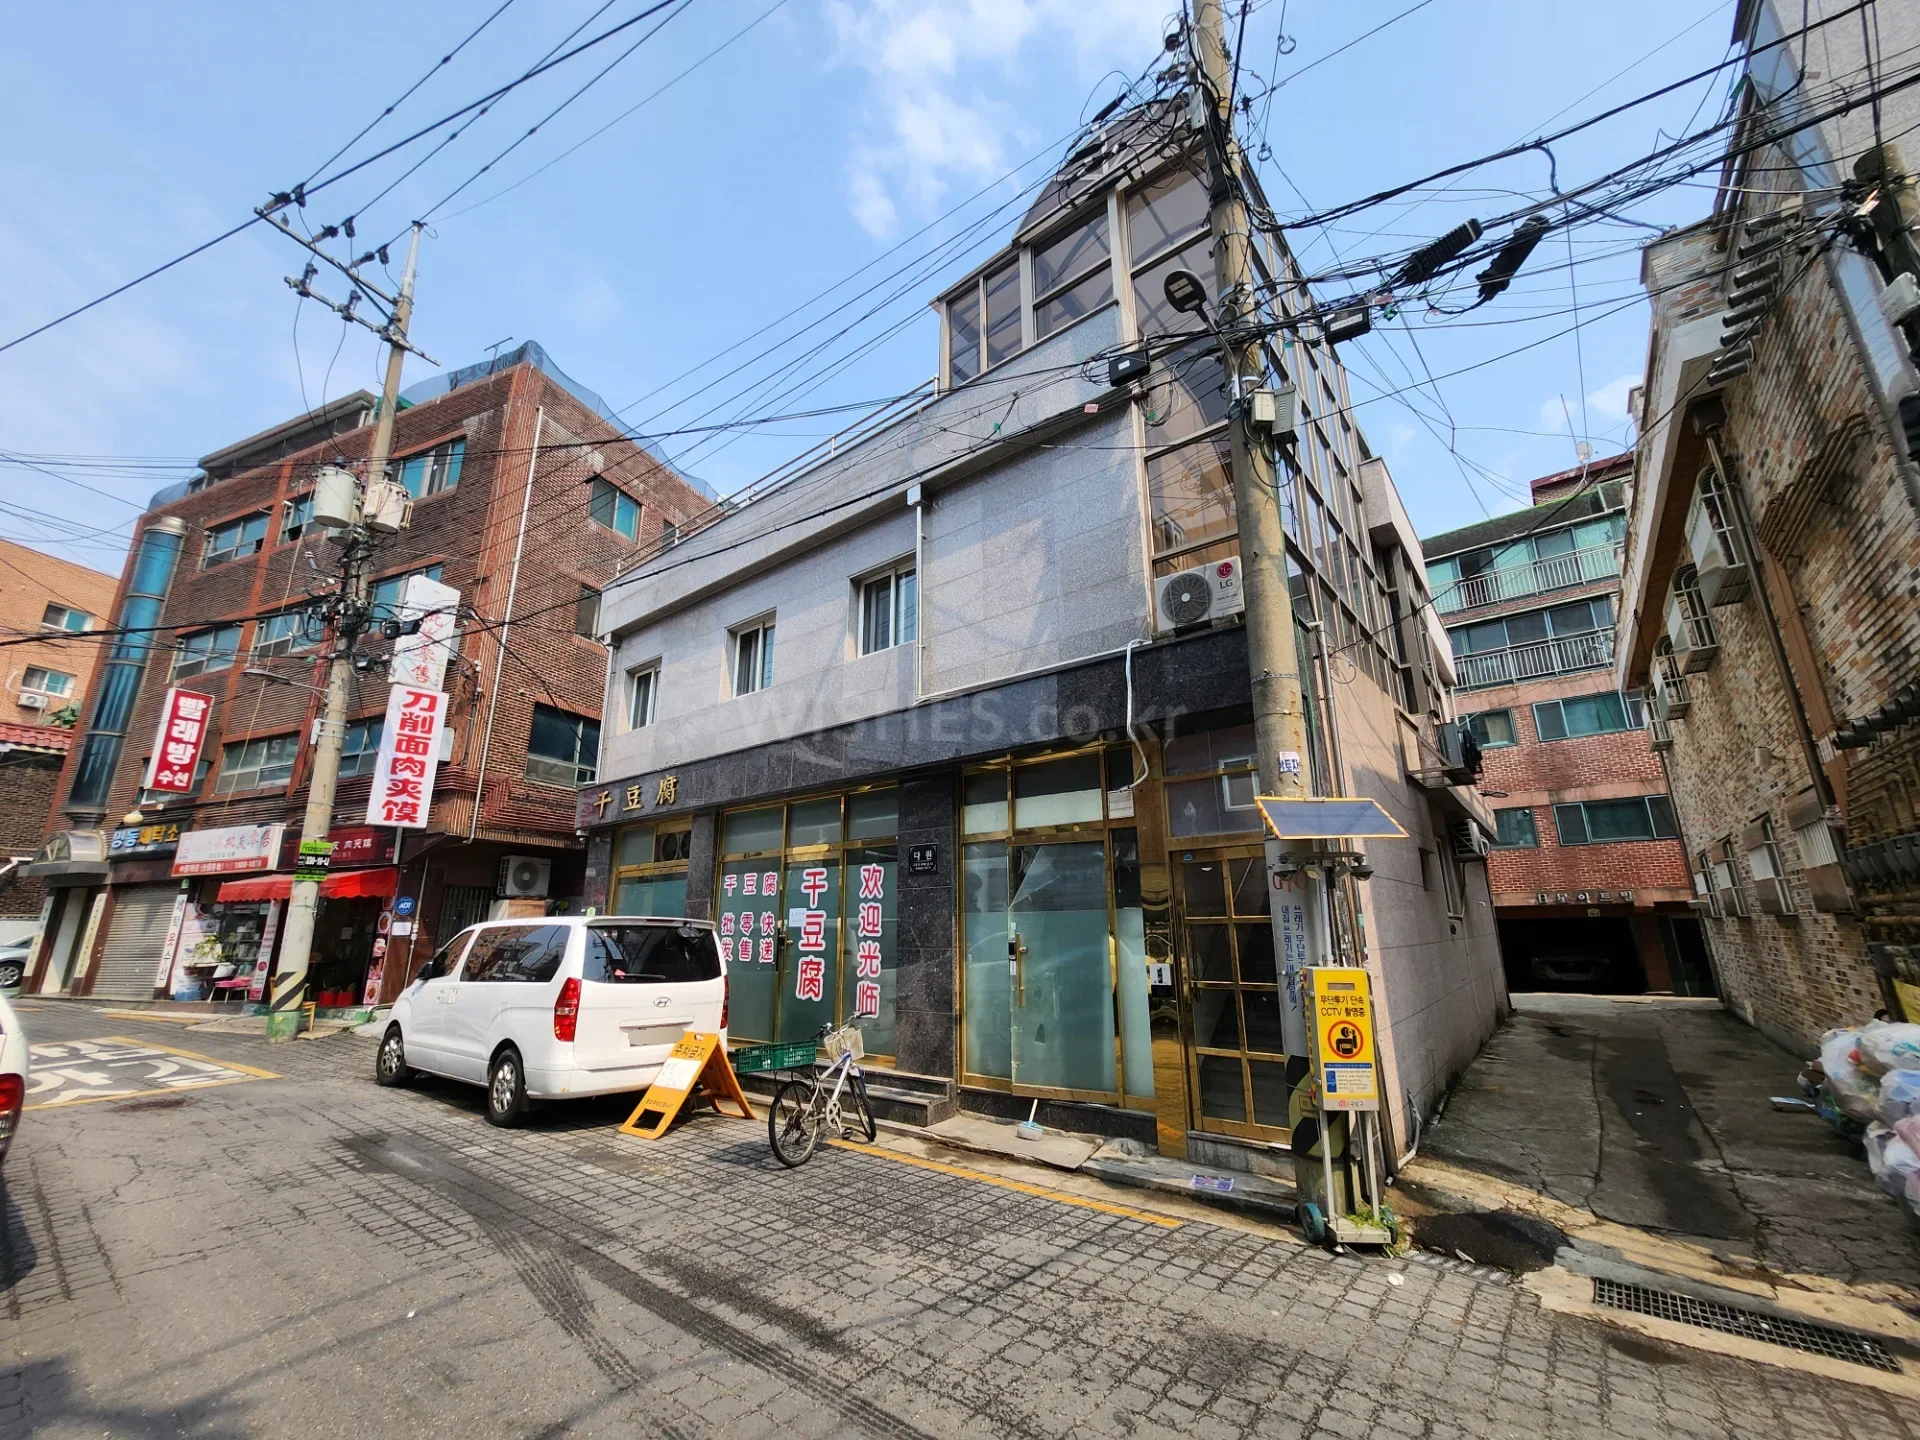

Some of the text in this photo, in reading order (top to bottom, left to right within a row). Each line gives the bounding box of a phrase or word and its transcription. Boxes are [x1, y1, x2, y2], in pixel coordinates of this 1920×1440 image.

[1219, 579, 1234, 589] LG
[382, 690, 438, 823] 刀削面肉夹馍
[593, 775, 678, 818] 干豆腐
[724, 871, 778, 897] 干豆腐
[398, 901, 412, 910] ADT
[796, 867, 828, 1001] 干豆腐
[857, 863, 884, 1019] 欢迎光临
[1320, 995, 1365, 1005] 무단투기 단속
[1320, 1007, 1342, 1016] CCTV
[674, 1043, 709, 1060] 주차금지
